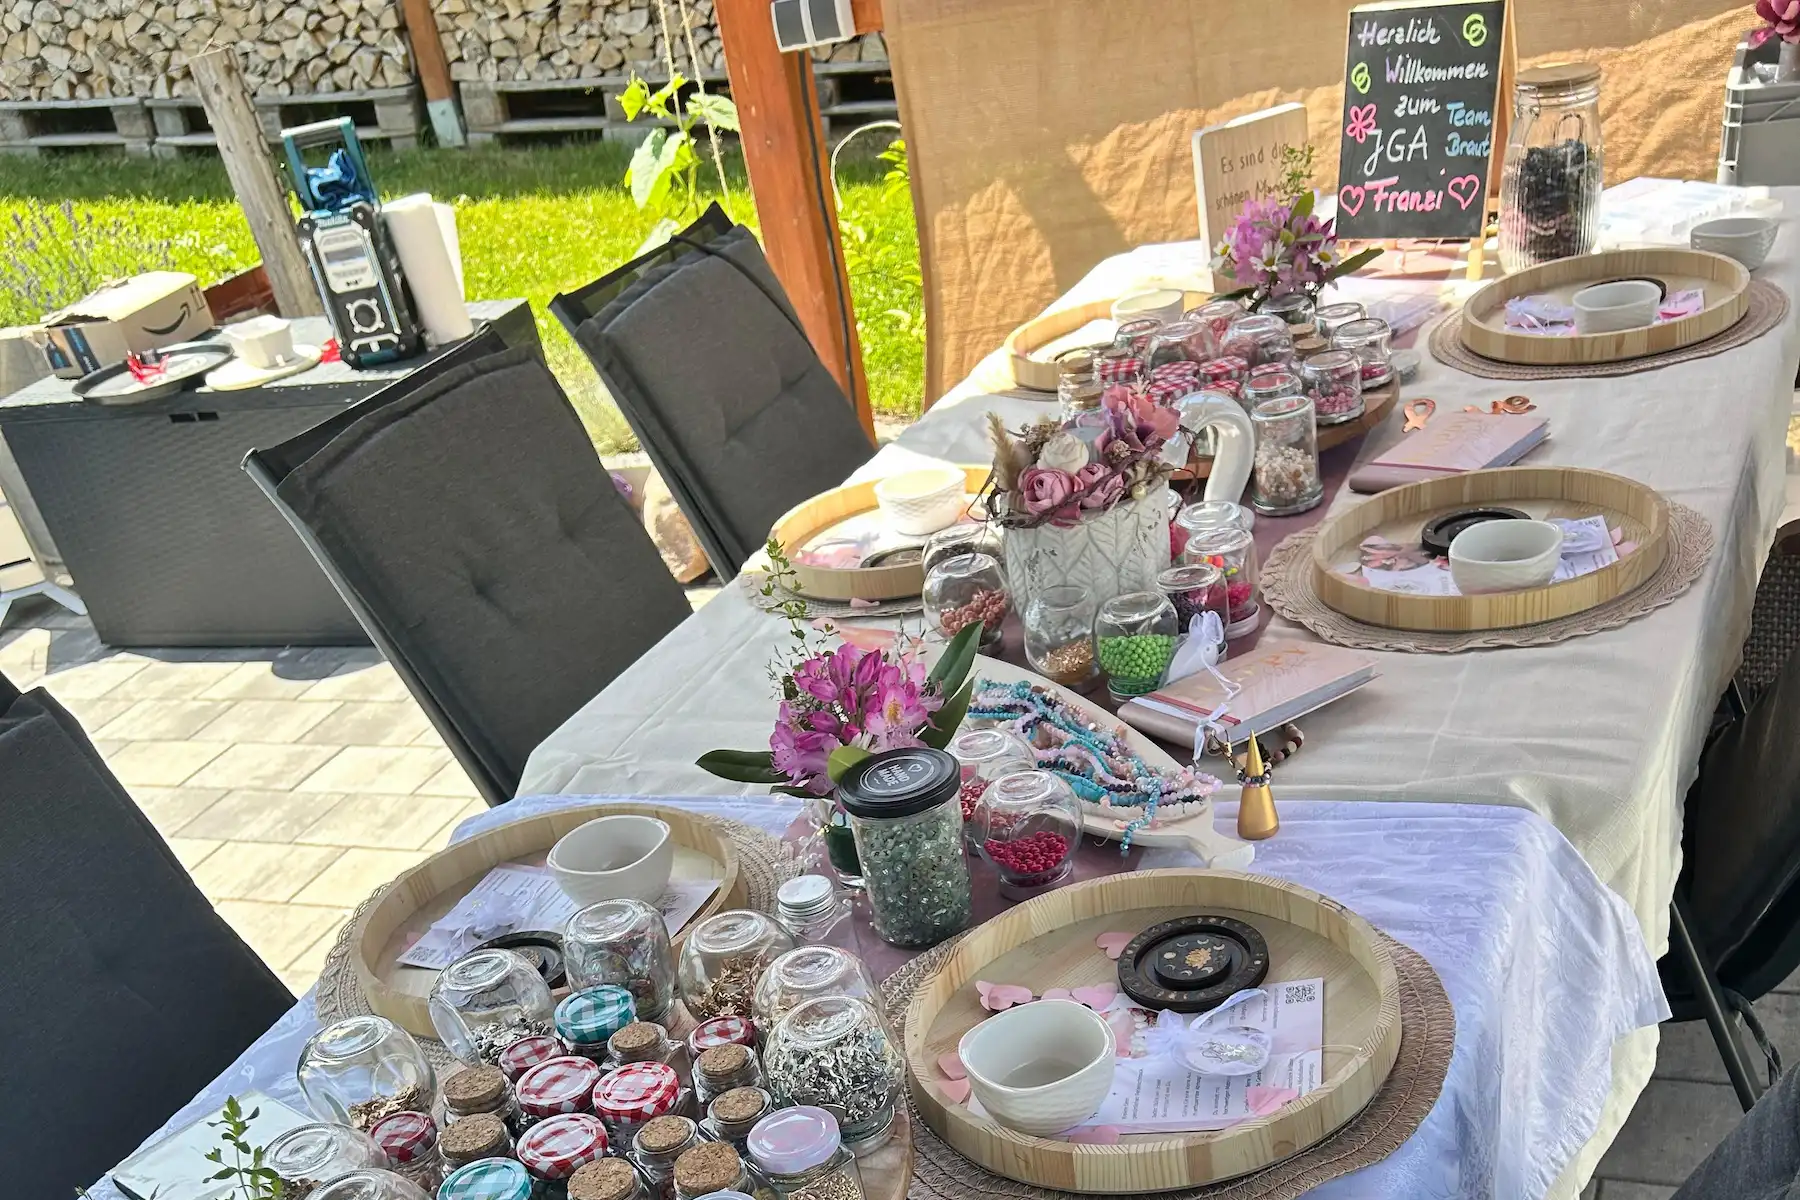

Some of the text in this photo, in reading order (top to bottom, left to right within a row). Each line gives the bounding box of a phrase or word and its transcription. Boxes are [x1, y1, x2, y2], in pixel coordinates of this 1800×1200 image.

[1357, 17, 1440, 48] Herzlich
[1385, 53, 1489, 84] Willkommen
[1394, 95, 1440, 118] zum
[1446, 102, 1491, 127] Team
[1363, 124, 1428, 176] JGA
[1445, 132, 1490, 157] Braut
[1221, 156, 1234, 174] Es
[1240, 145, 1264, 169] sind
[1364, 168, 1446, 212] Franzi
[877, 768, 900, 786] MADE
[888, 764, 910, 782] HAND
